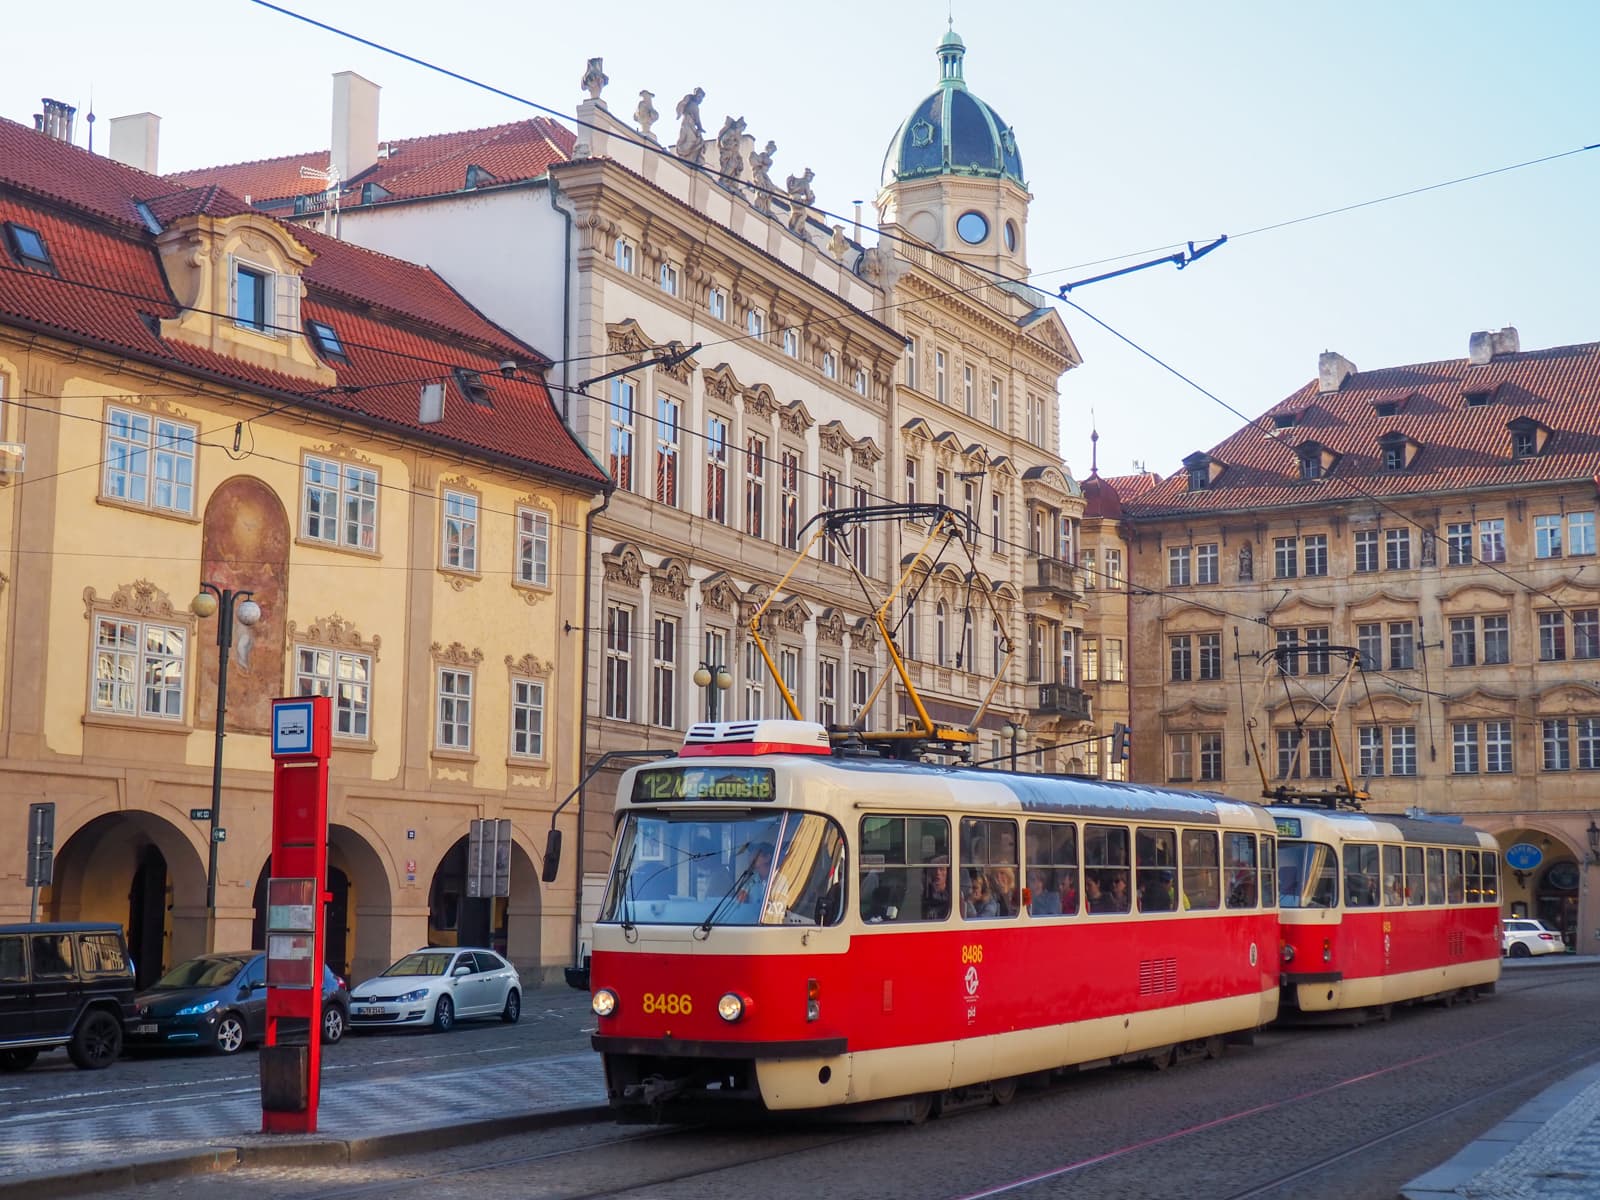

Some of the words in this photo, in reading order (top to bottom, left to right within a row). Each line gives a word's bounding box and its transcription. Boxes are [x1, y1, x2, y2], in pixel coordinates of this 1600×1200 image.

[644, 773, 673, 798] 12
[962, 944, 983, 963] 8486
[643, 992, 693, 1015] 8486
